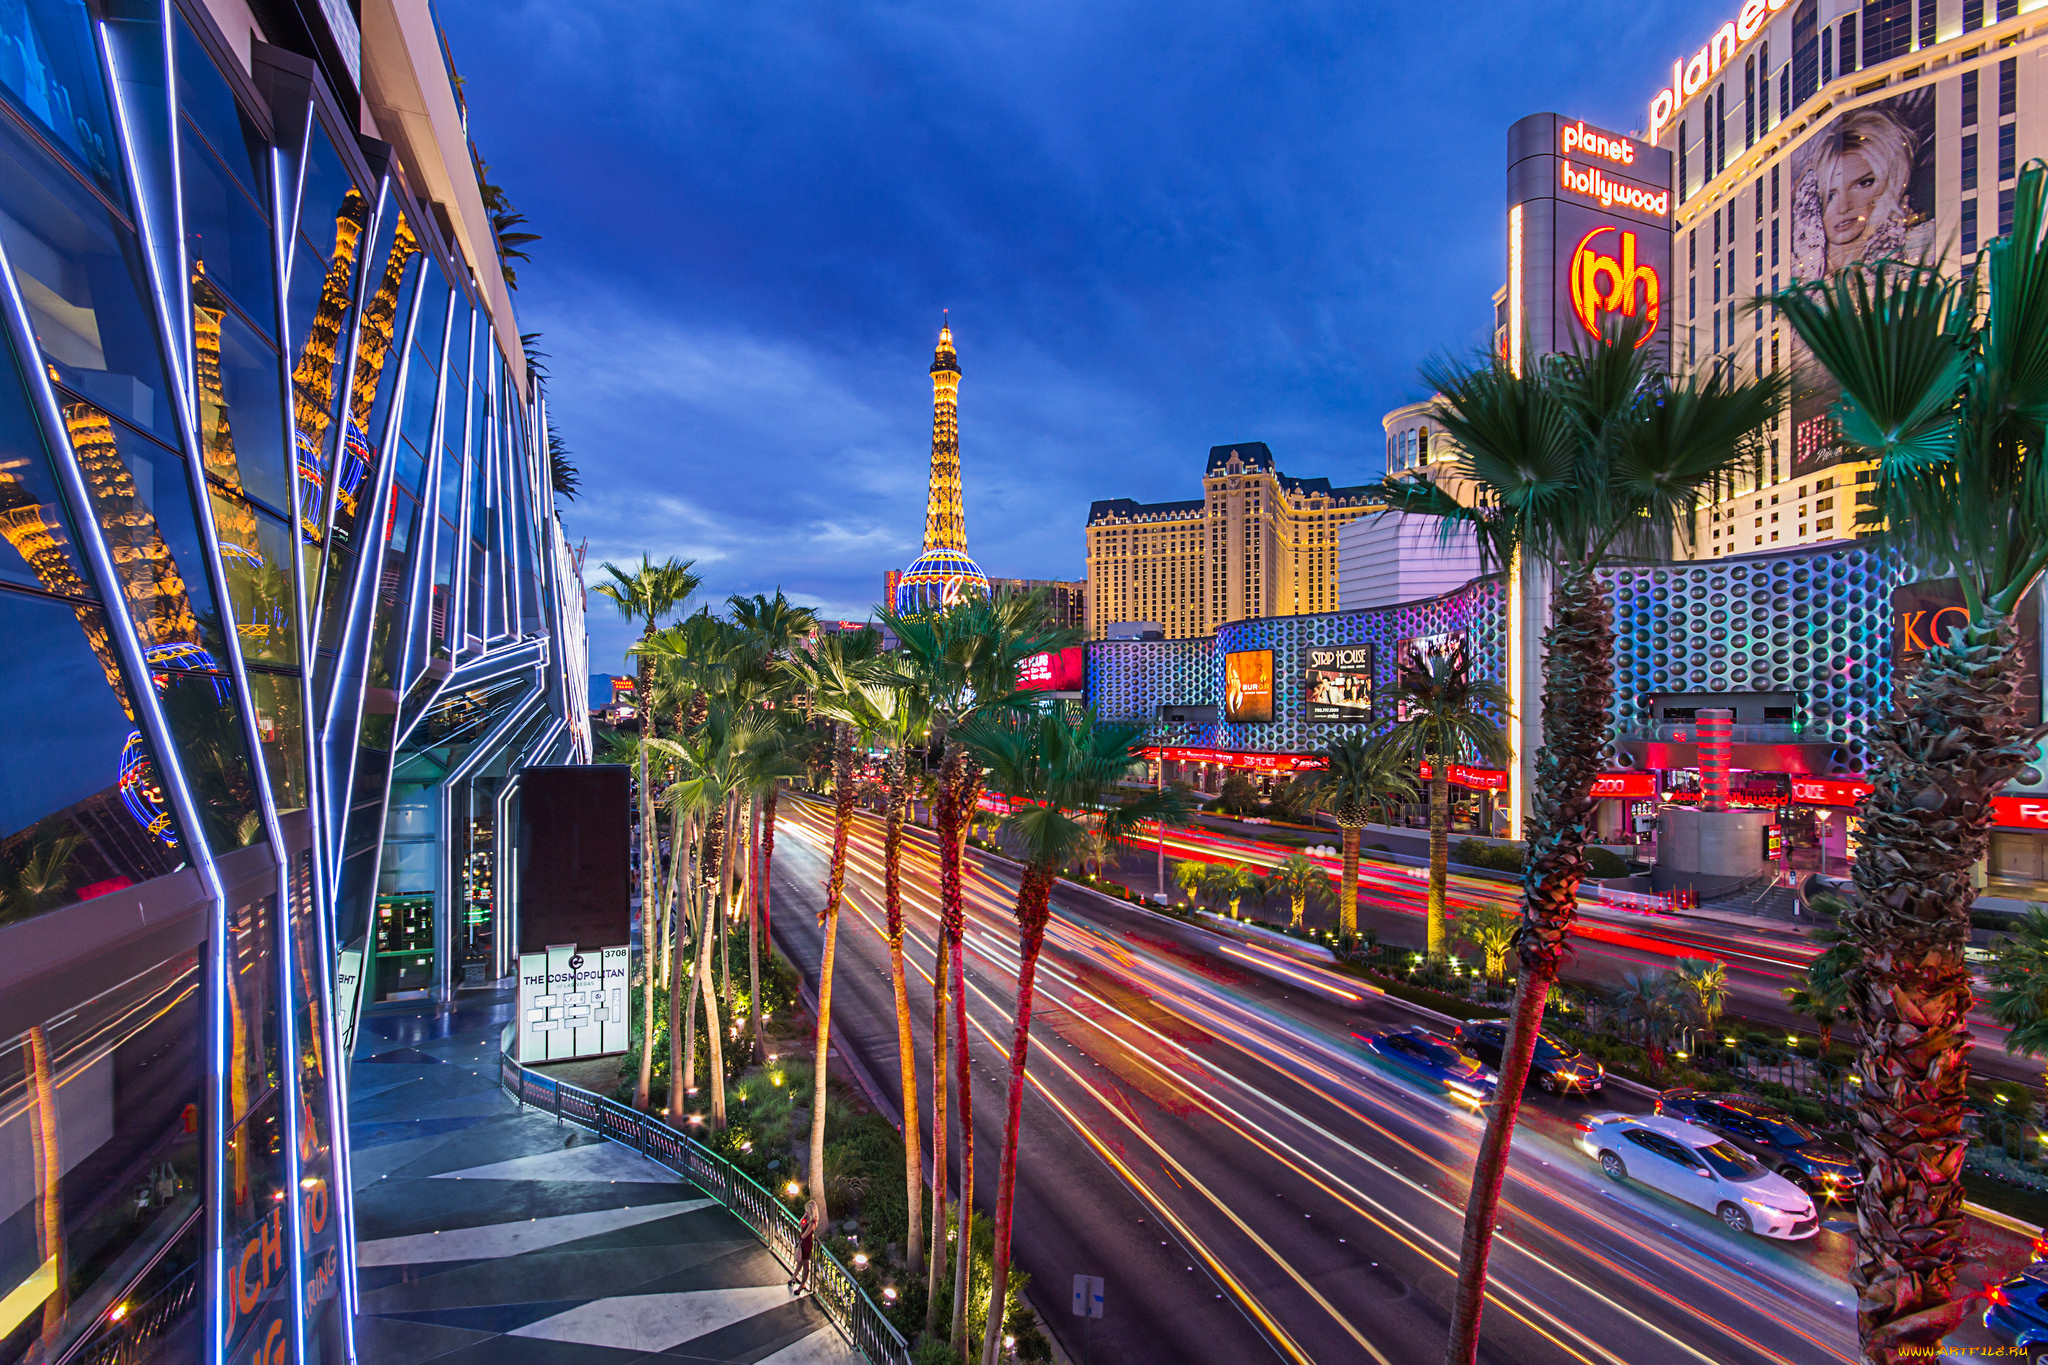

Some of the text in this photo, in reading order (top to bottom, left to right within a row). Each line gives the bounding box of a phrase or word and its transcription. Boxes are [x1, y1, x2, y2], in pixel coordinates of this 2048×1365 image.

[1563, 120, 1634, 165] planet
[1563, 158, 1669, 216] hollywood
[1902, 606, 1971, 652] KO
[1311, 649, 1366, 668] STRIP HOUSE
[2019, 804, 2048, 823] Fo
[604, 949, 627, 958] 3708
[523, 968, 625, 985] THE COSMOPOLITAN
